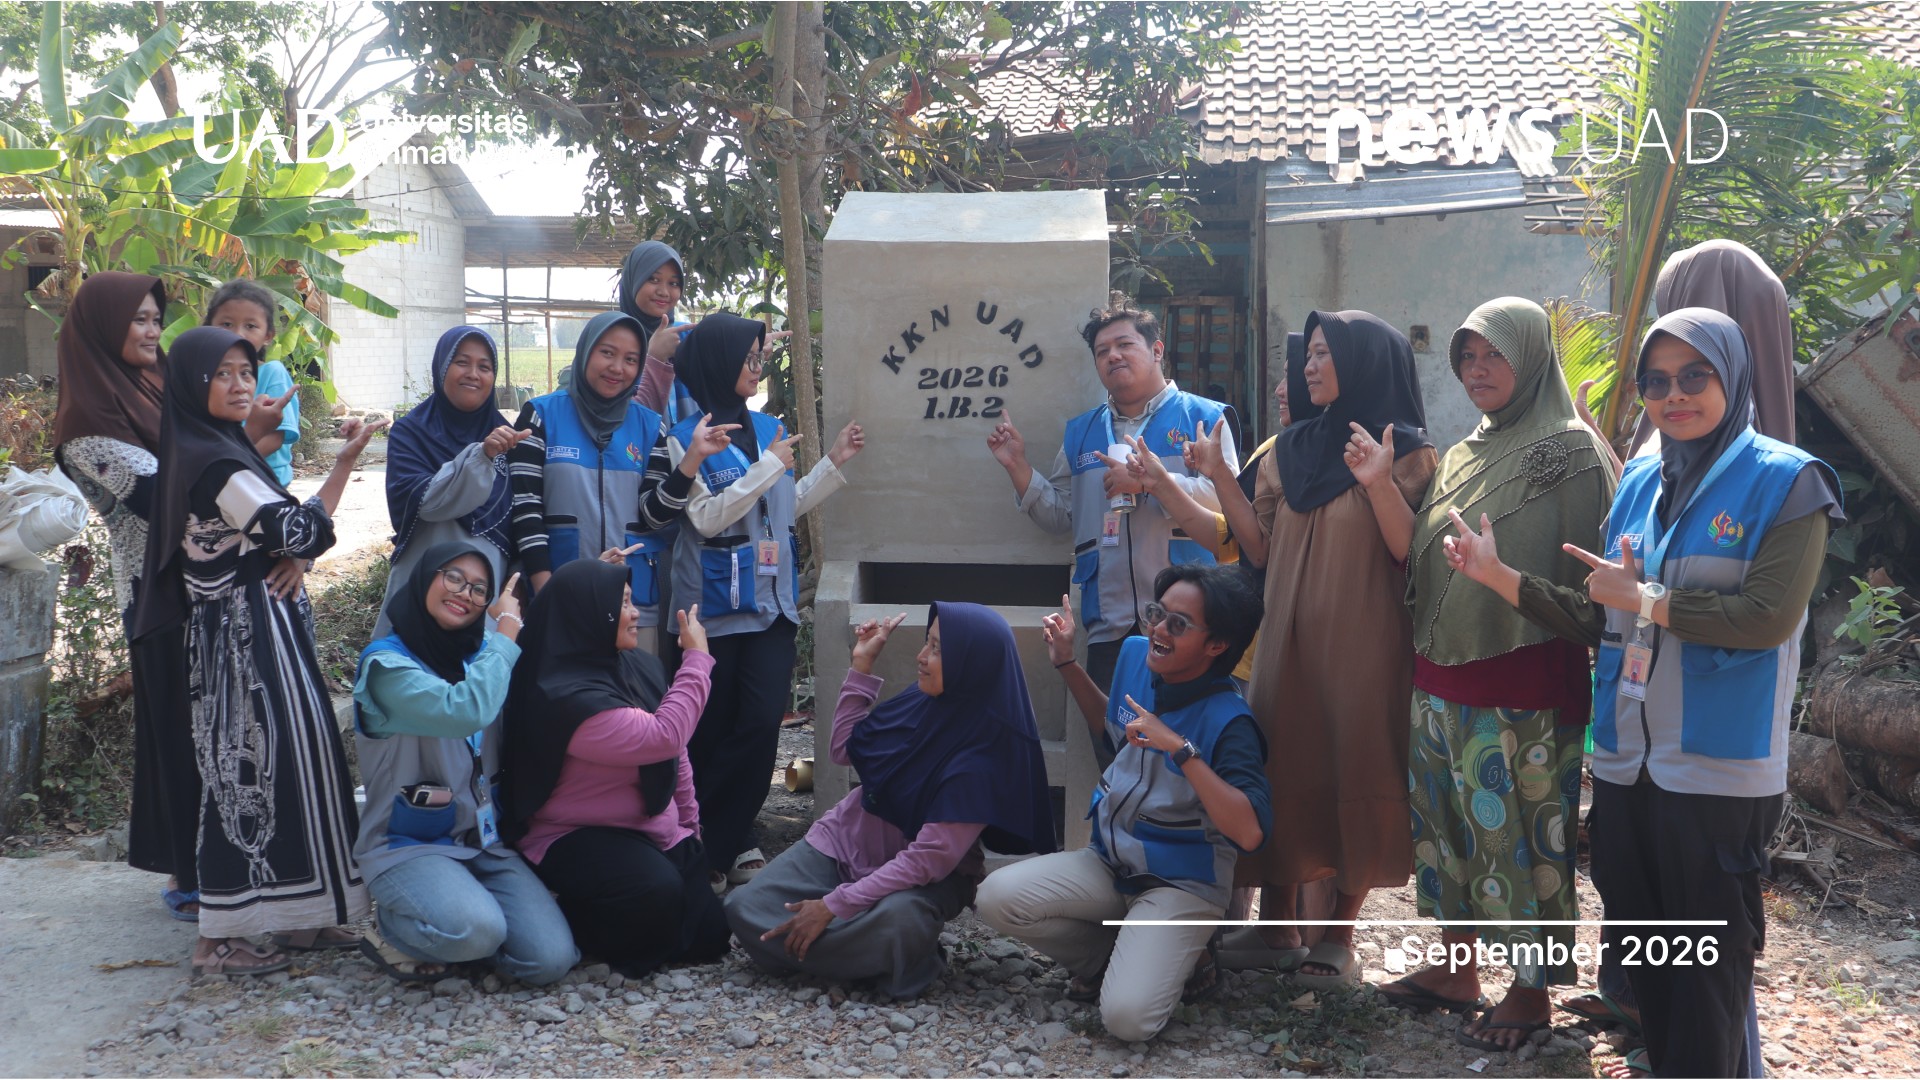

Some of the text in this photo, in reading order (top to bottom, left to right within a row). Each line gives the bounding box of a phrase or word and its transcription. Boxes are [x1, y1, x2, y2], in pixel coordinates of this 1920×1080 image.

[882, 301, 1044, 375] KKN UAD
[918, 365, 1009, 390] 2026
